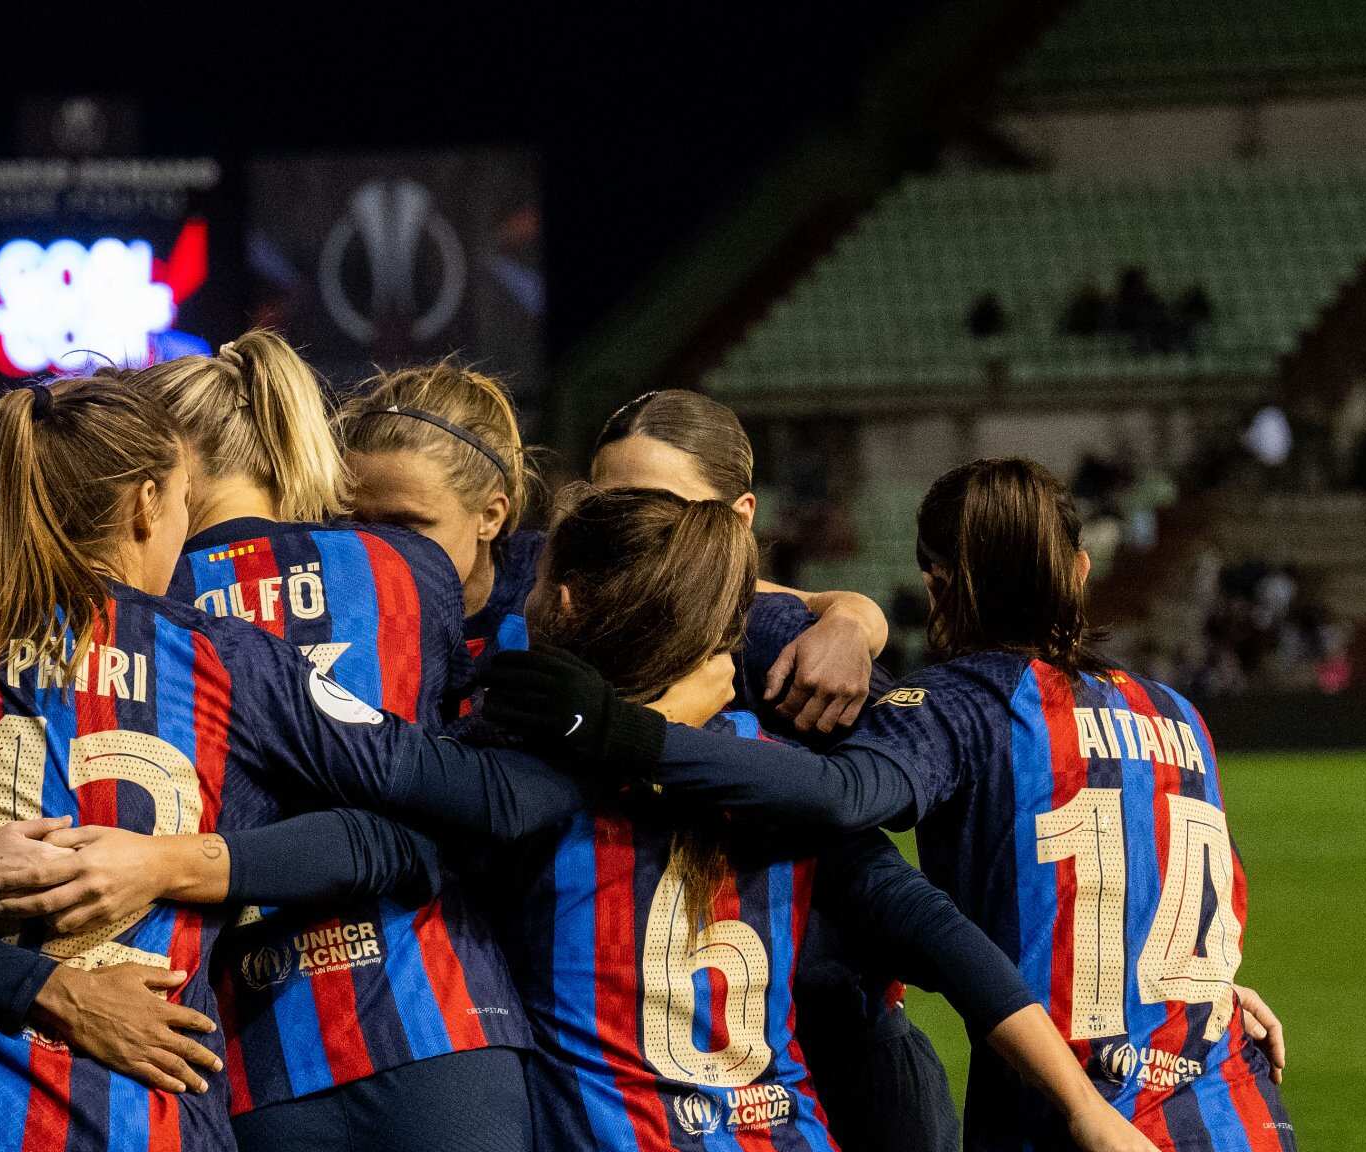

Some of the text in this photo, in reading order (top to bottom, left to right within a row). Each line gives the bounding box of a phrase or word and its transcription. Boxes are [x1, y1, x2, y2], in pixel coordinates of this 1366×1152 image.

[1073, 707, 1206, 774] AITANA
[1035, 787, 1242, 1043] 14
[293, 921, 377, 951] UNHCR
[298, 939, 380, 971] ACNUR
[642, 860, 772, 1088] 6
[1140, 1047, 1202, 1075] UNHCR
[727, 1084, 790, 1109] UNHCR
[726, 1100, 790, 1126] ACNUR
